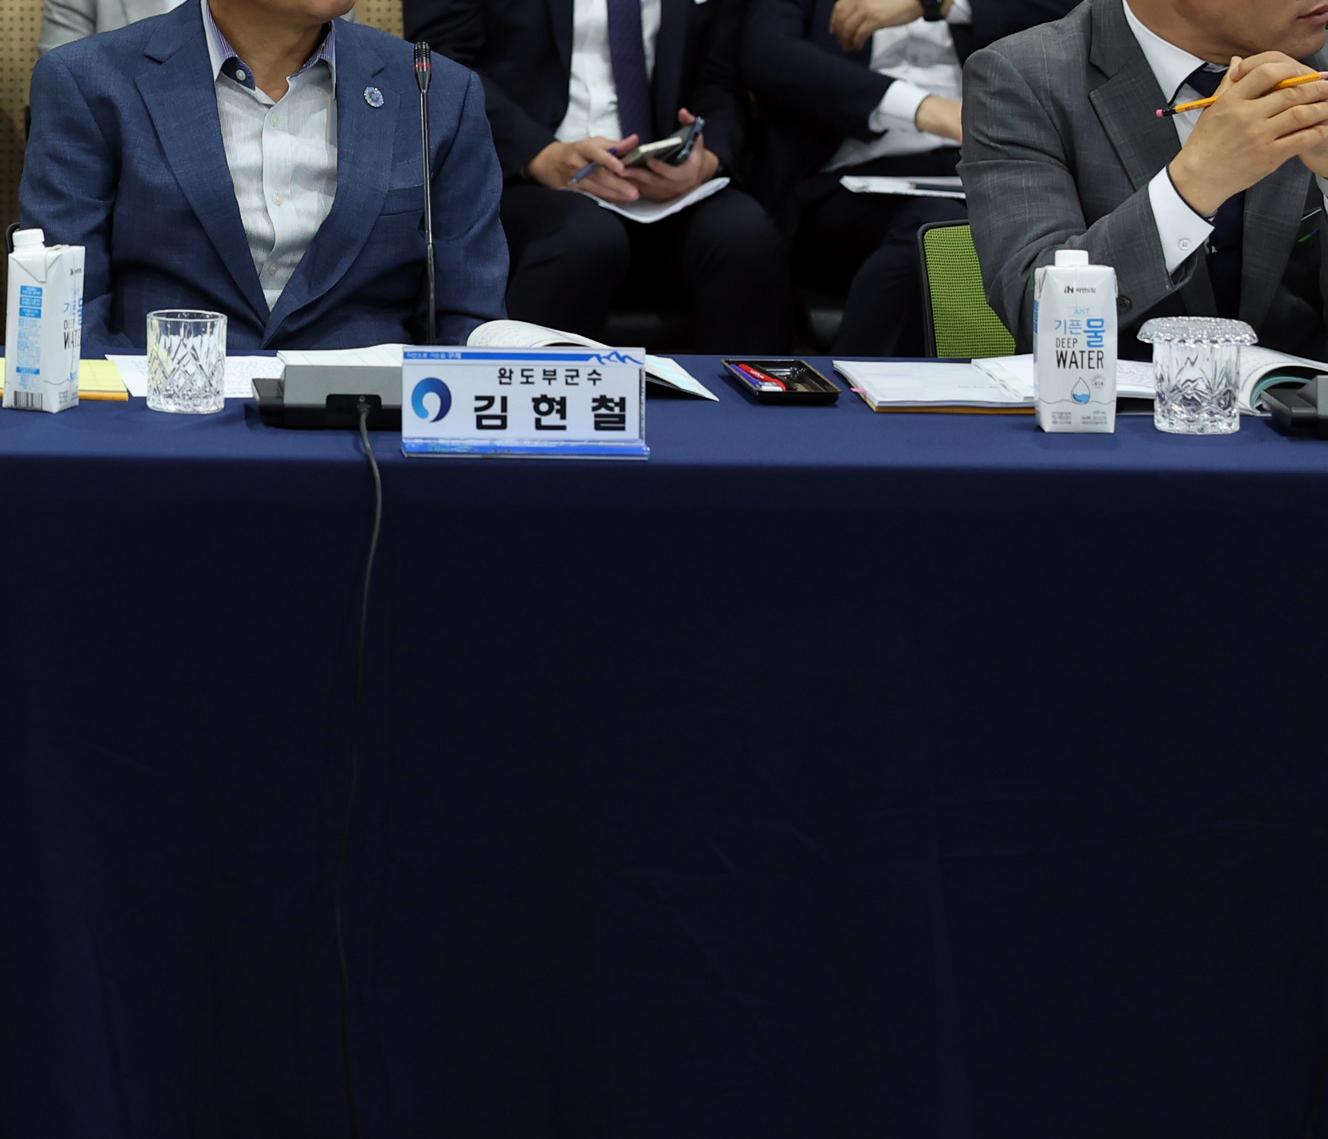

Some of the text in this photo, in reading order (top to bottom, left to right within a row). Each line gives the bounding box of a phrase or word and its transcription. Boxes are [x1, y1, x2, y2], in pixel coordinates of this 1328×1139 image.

[1055, 337, 1078, 348] DEEP
[1055, 350, 1105, 369] WATER
[497, 368, 603, 386] 완도부군수
[473, 393, 627, 431] 김현철
